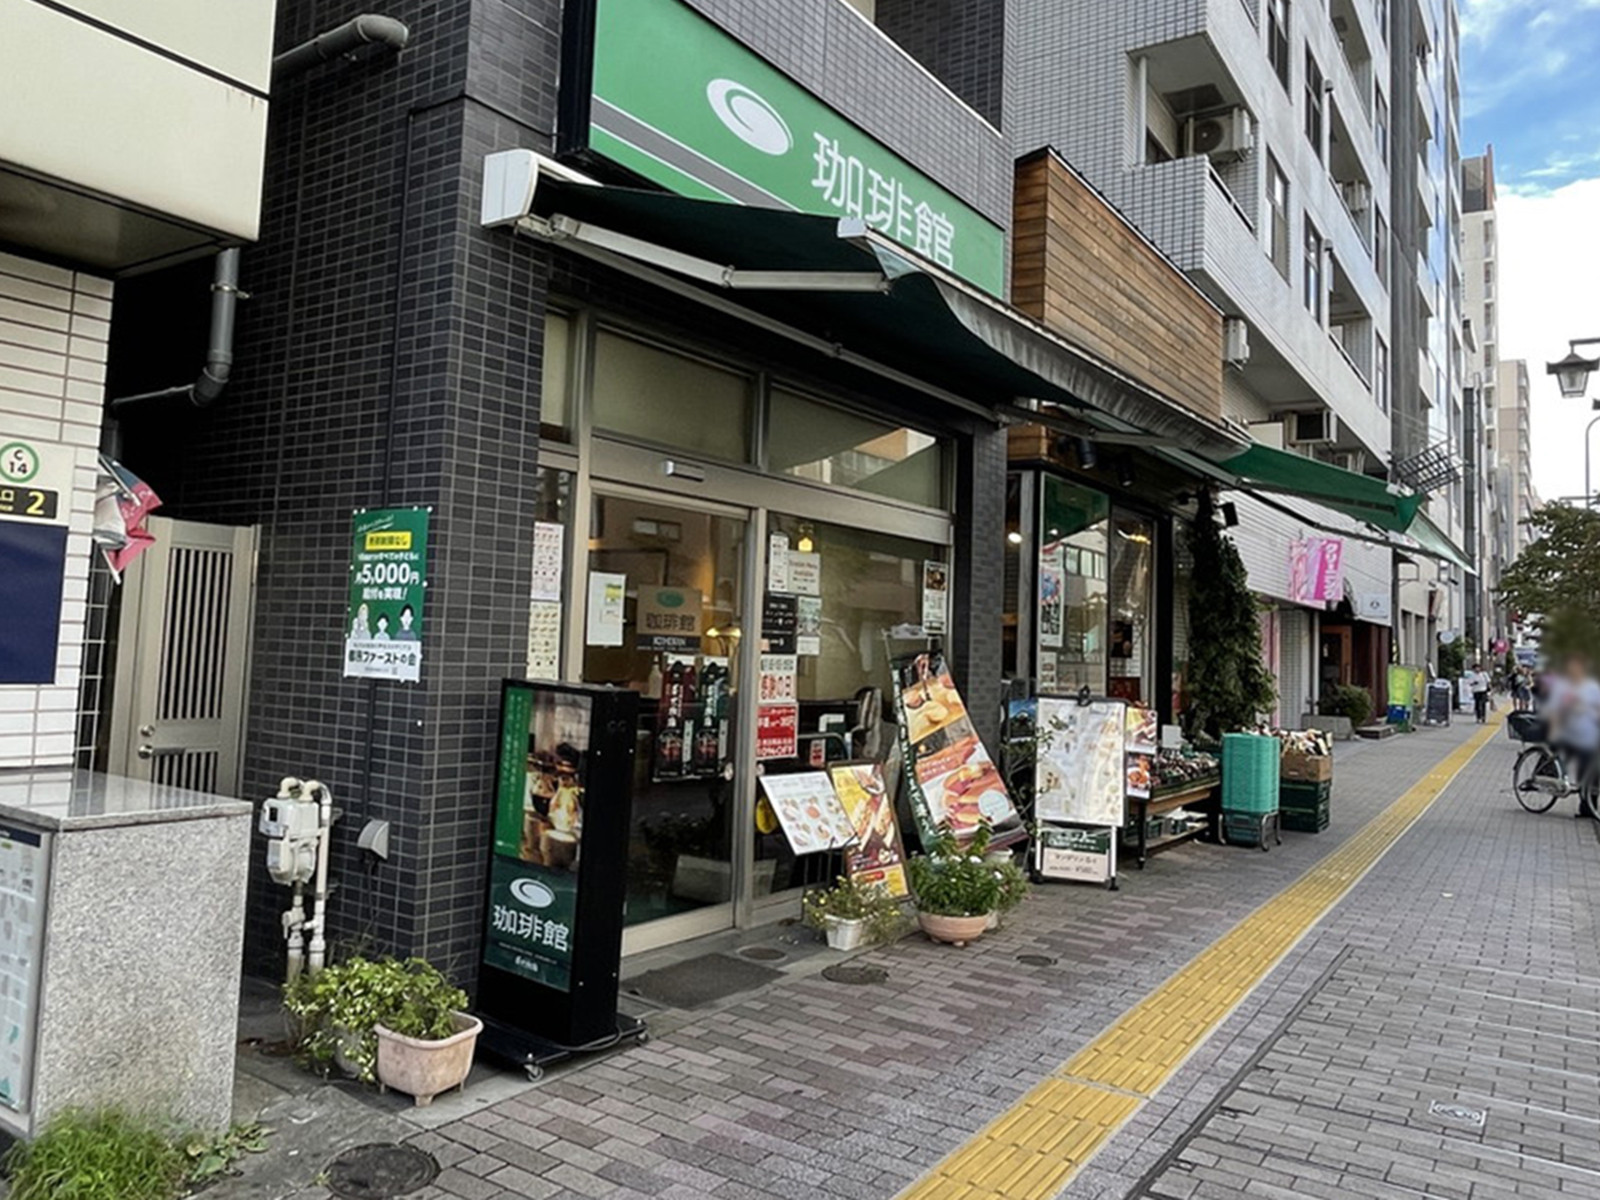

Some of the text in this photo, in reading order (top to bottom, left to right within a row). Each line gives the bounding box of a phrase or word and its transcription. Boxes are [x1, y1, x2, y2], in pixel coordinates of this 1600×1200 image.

[811, 131, 955, 270] 珈琲館
[14, 449, 23, 461] C
[9, 461, 27, 474] 14
[26, 491, 45, 515] 2
[492, 904, 569, 952] 珈琲館
